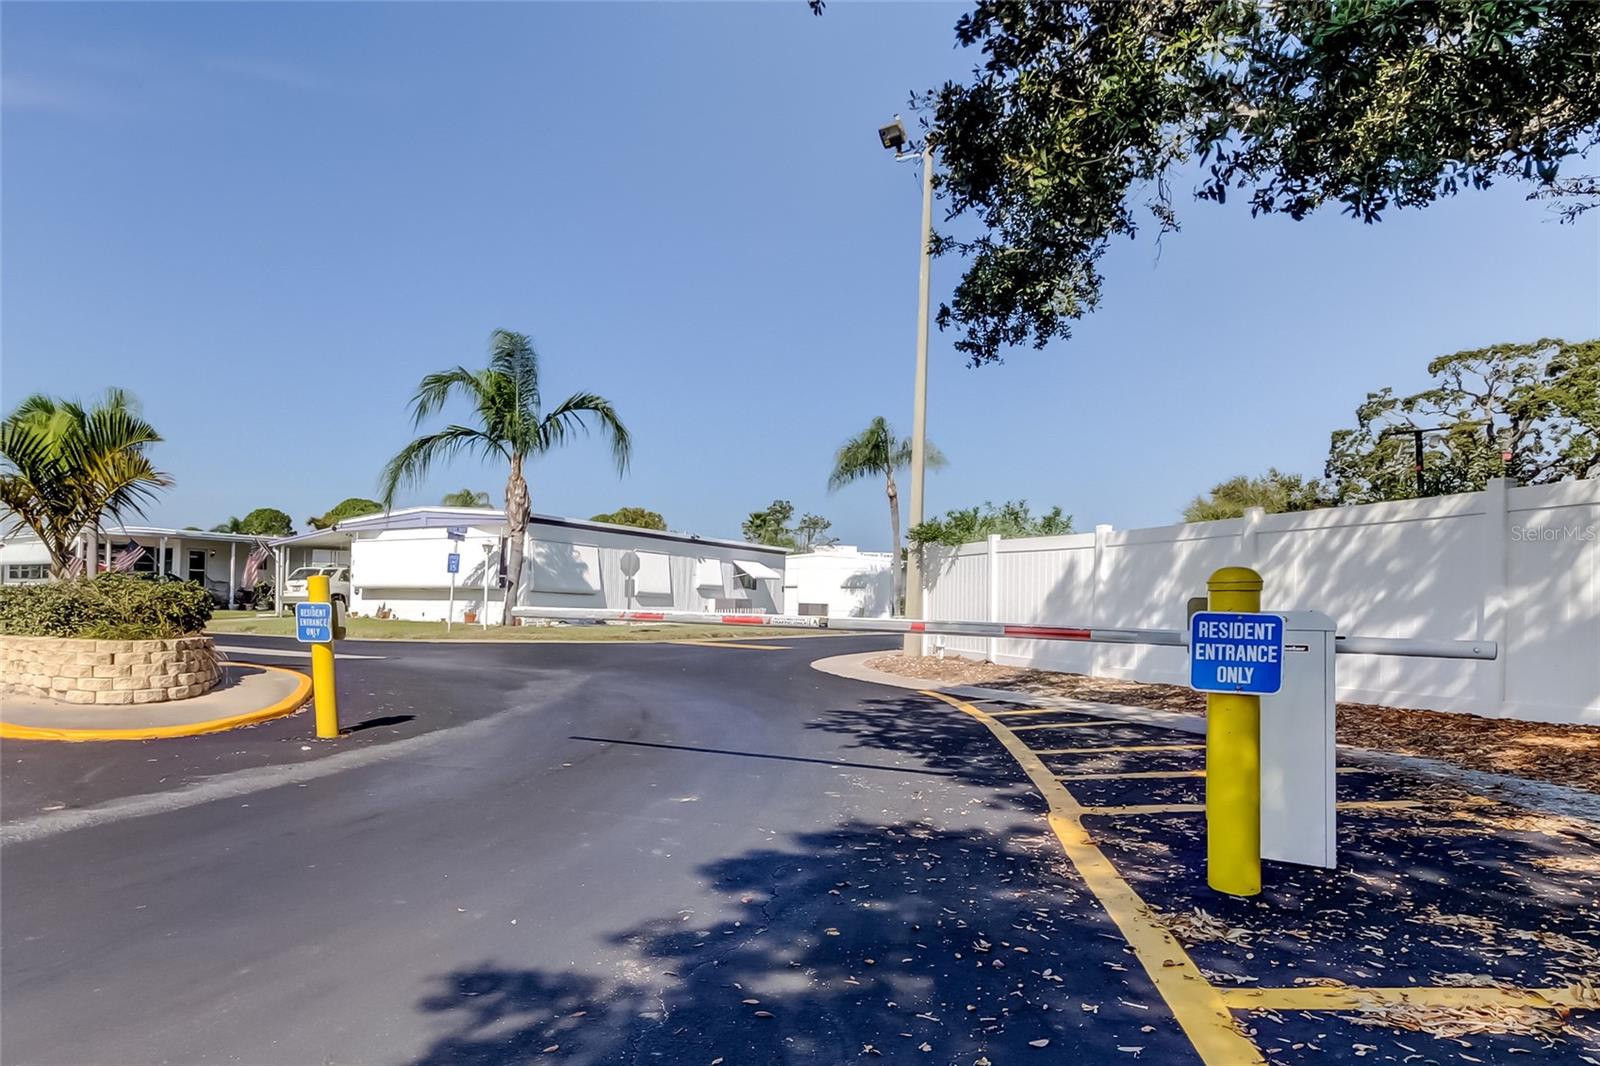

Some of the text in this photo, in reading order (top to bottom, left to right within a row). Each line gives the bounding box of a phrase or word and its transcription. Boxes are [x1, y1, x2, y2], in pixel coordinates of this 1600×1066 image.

[300, 608, 326, 617] RESIDENT
[300, 618, 327, 627] ENTRANCE
[305, 628, 320, 636] ONLY
[1198, 621, 1276, 640] RESIDENT
[1195, 643, 1278, 663] ENTRANCE
[1216, 666, 1254, 684] ONLY
